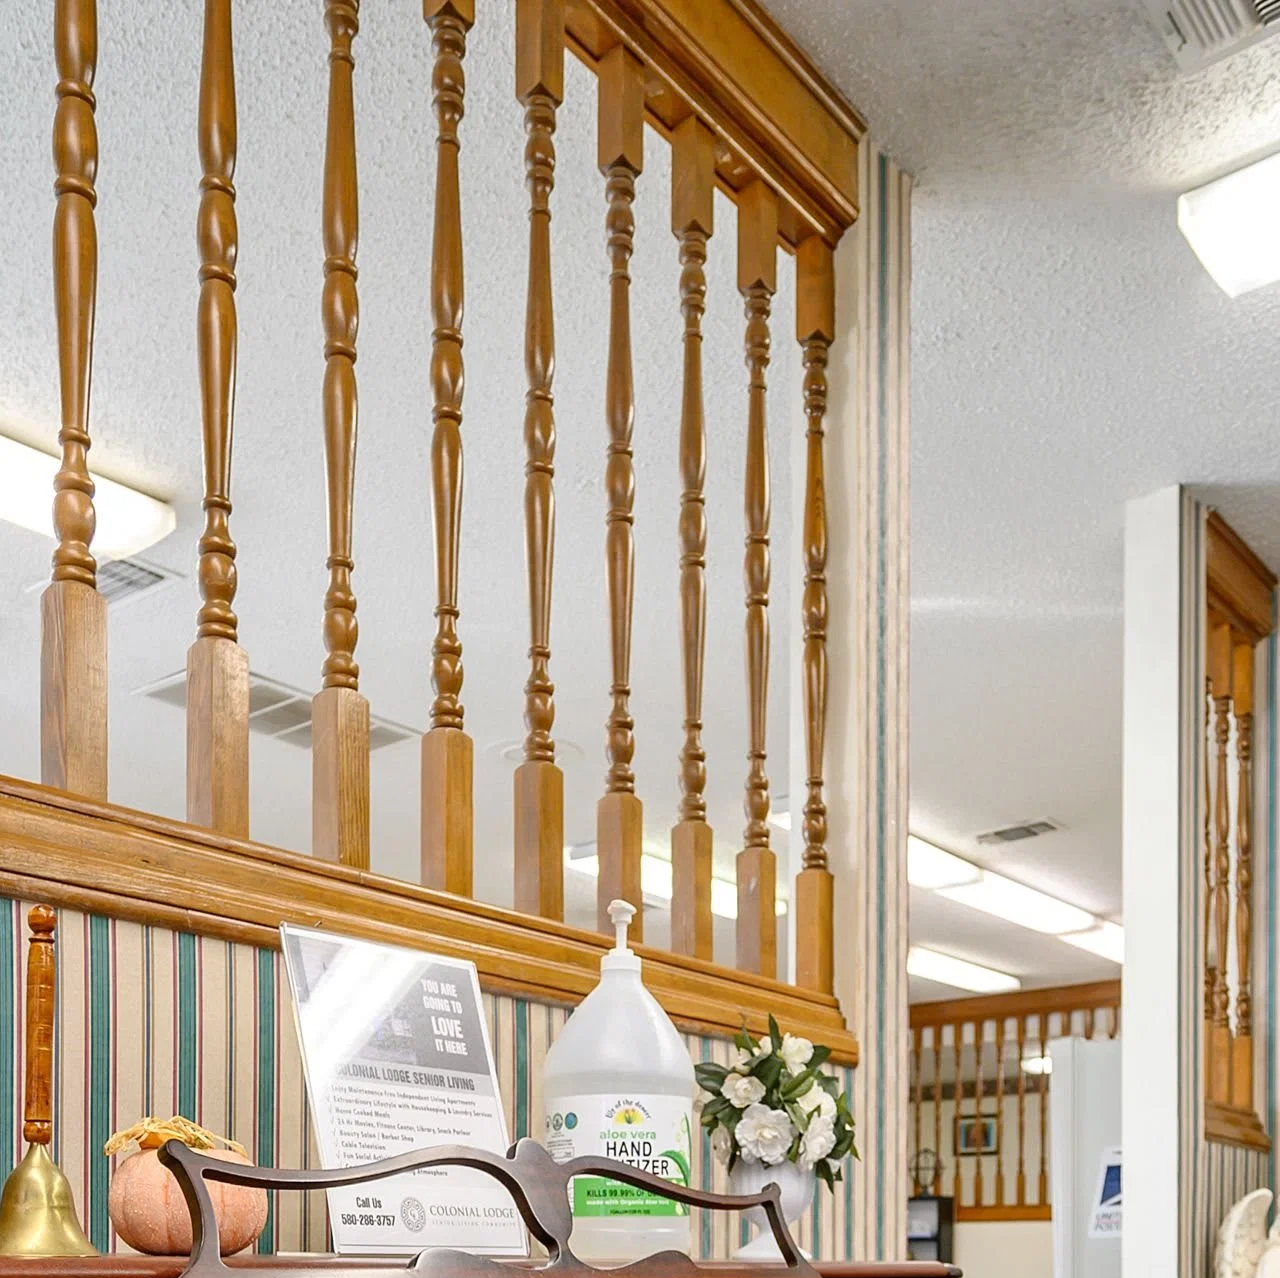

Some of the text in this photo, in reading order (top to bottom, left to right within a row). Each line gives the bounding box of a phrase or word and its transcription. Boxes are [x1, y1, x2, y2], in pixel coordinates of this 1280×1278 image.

[421, 979, 457, 998] YOU ARE
[423, 996, 463, 1014] GOING TO
[431, 1016, 464, 1038] LOVE
[435, 1039, 469, 1055] IT HERE
[336, 1064, 475, 1091] OLONIAL LODGE SENIOR LIVING
[348, 1086, 383, 1097] Maintenance
[397, 1092, 429, 1101] Independent
[430, 1095, 446, 1104] Living
[447, 1097, 476, 1106] Apartments
[333, 1096, 372, 1107] Extraordinary
[373, 1099, 397, 1109] Lifestyle
[411, 1104, 446, 1115] Housekeeping
[453, 1108, 472, 1117] Laundry
[473, 1110, 493, 1118] Services
[353, 1108, 373, 1117] Cooked
[374, 1110, 391, 1119] Meals
[376, 1121, 396, 1129] Fitness
[437, 1127, 452, 1135] Snack
[600, 1129, 657, 1140] aloe vera
[340, 1130, 360, 1139] Beauty
[401, 1134, 414, 1143] Shop
[359, 1142, 386, 1150] Television
[606, 1141, 652, 1157] HAND
[355, 1152, 371, 1160] Social
[417, 1168, 448, 1177] Atmosphere
[587, 1188, 608, 1198] KILLS
[609, 1188, 635, 1198] 99.99%
[356, 1197, 382, 1208] Call Us
[429, 1205, 515, 1218] COLONIAL LODGE
[341, 1213, 395, 1226] 580-286-3757
